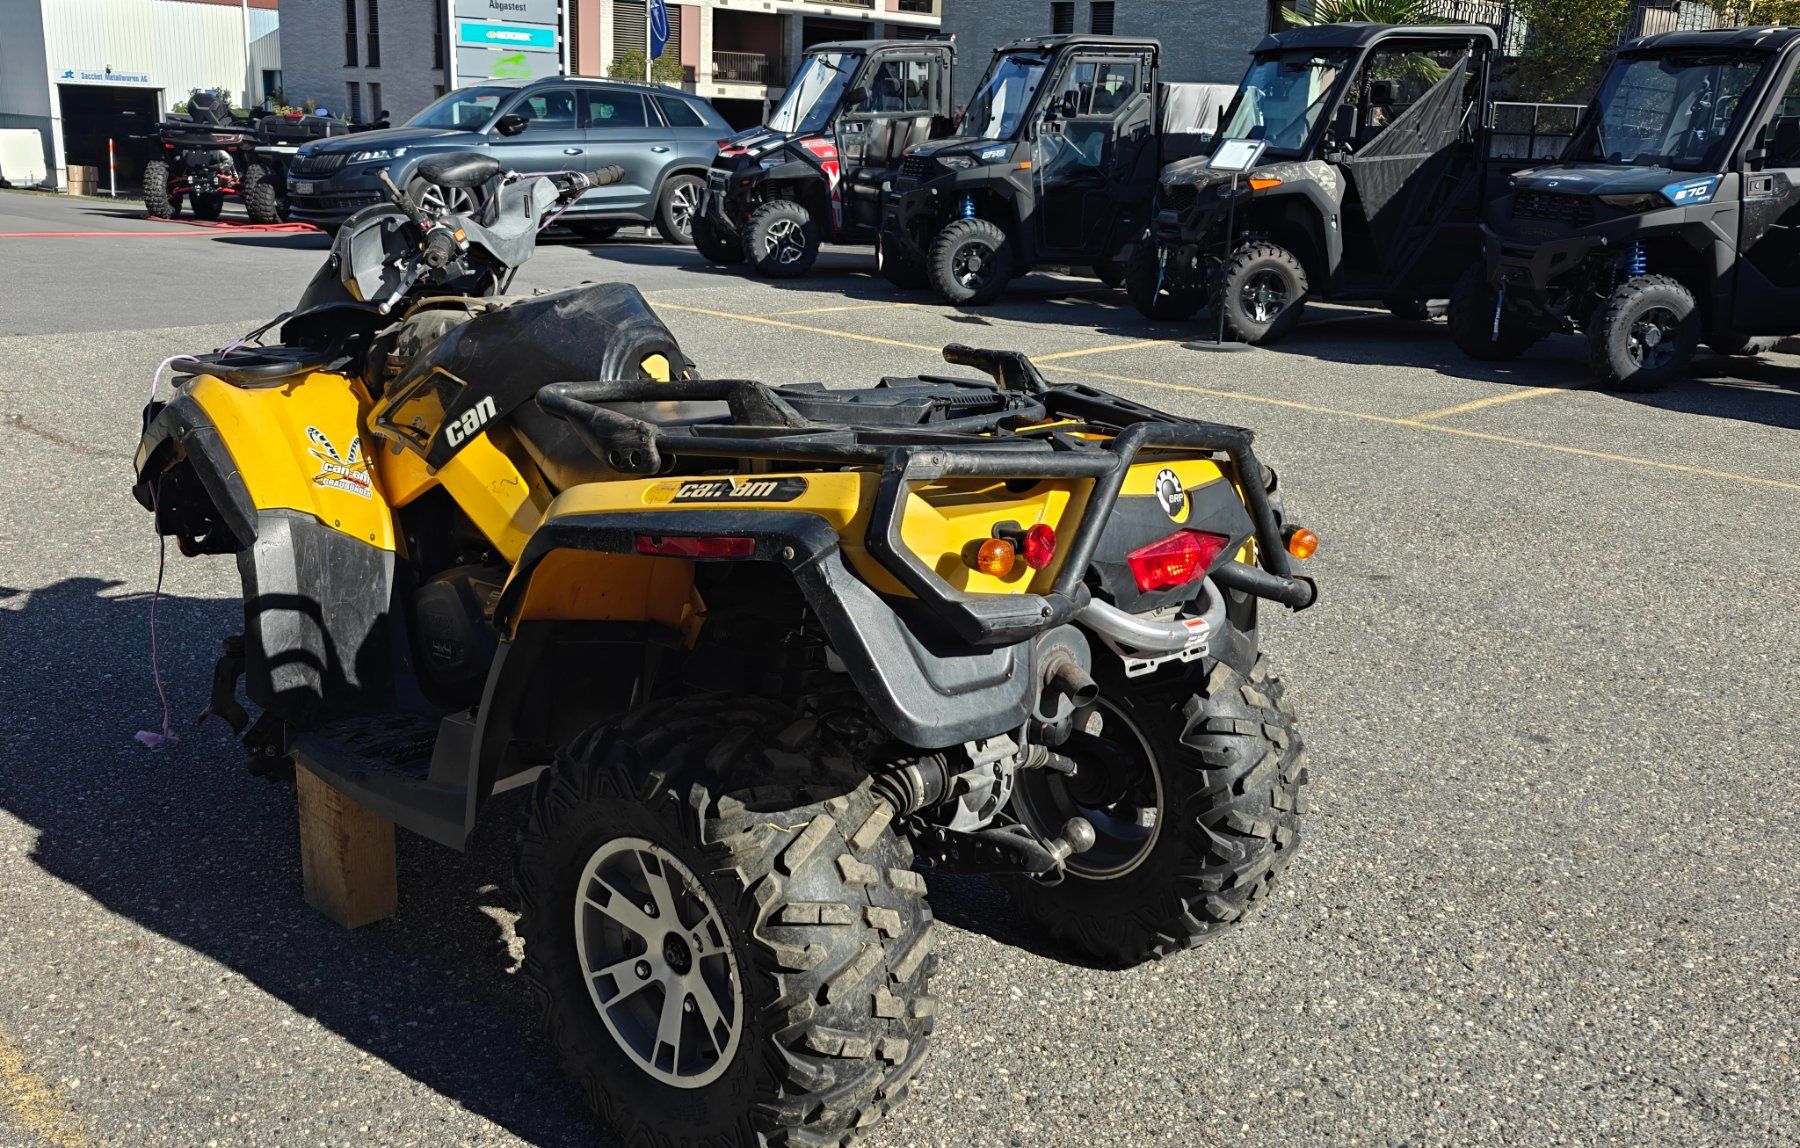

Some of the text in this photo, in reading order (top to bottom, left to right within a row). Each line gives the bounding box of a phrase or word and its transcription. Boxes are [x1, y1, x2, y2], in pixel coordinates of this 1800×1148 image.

[489, 0, 526, 11] Abgastest
[445, 395, 497, 448] can
[1169, 493, 1184, 503] BRP
